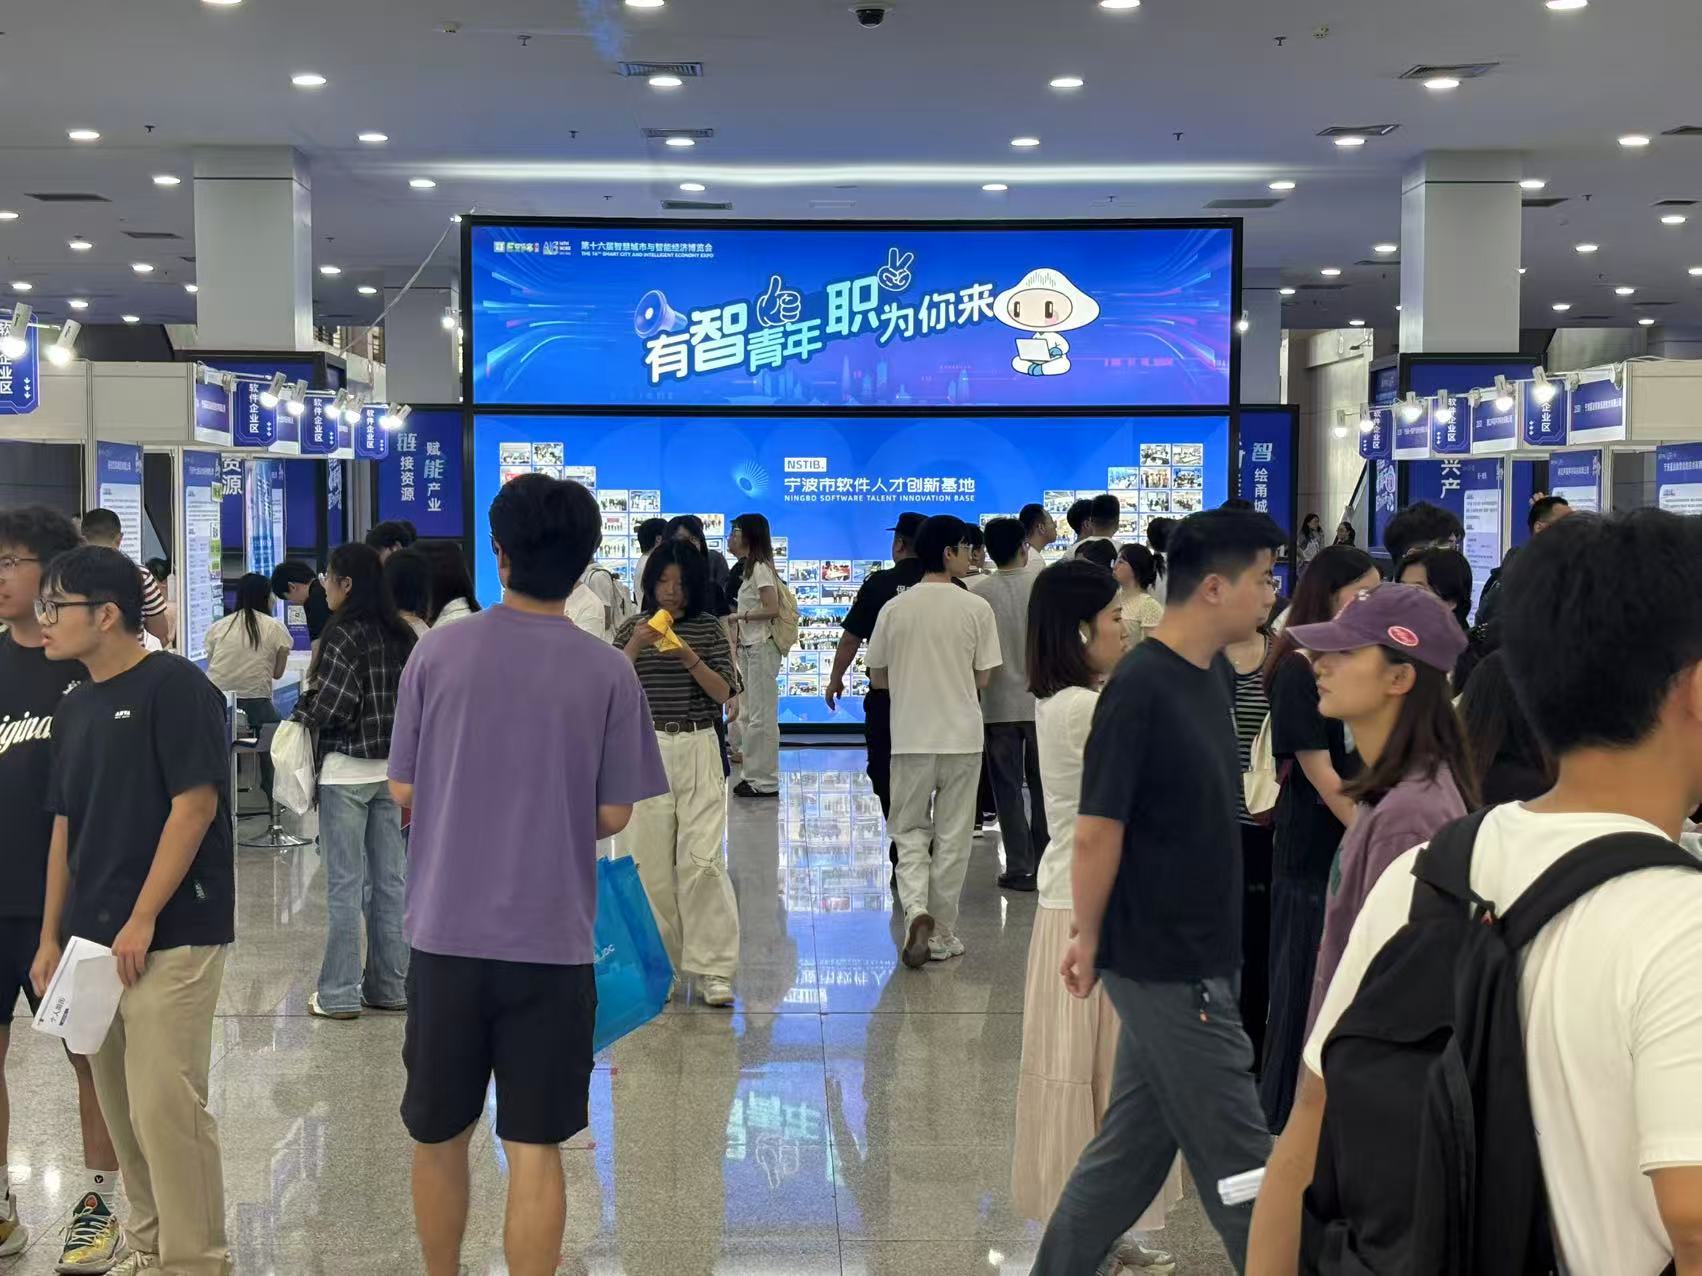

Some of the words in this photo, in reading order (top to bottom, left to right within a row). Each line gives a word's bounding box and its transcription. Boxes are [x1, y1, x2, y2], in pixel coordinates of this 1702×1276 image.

[249, 383, 260, 434] 软件企业区
[314, 398, 324, 443] 软件企业区
[366, 409, 376, 449] 软件企业区
[397, 433, 417, 501] 链接资源
[424, 441, 444, 512] 赋能产业
[784, 477, 976, 493] 宁波市软件人才创新基地
[1252, 443, 1273, 513] 智绘甬城
[784, 494, 817, 502] NINGBO
[820, 494, 864, 502] SOFTWARE
[867, 494, 896, 502] TALENT
[899, 494, 951, 502] INNOVATION
[954, 494, 975, 502] BASE
